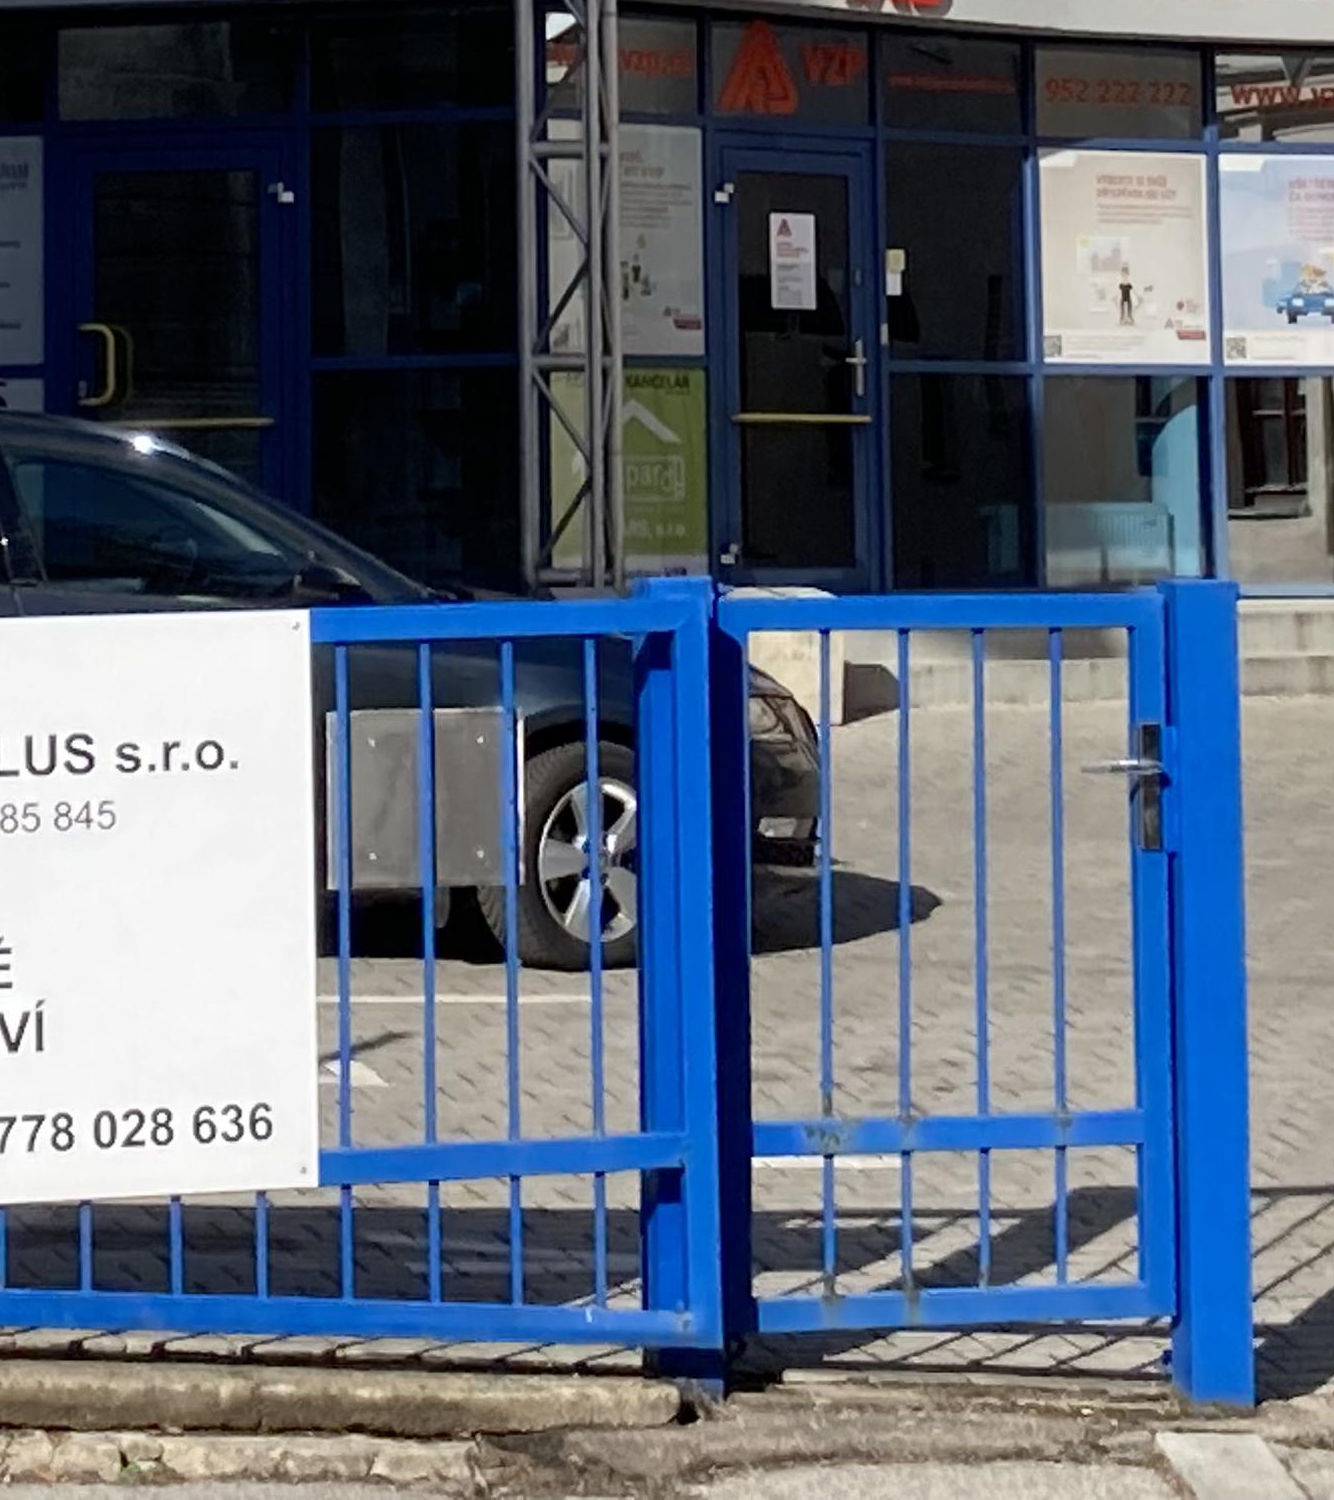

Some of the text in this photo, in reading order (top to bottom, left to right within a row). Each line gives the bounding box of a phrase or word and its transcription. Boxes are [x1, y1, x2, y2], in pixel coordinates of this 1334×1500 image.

[1045, 78, 1089, 102] 952
[116, 740, 238, 774] s.r.o.
[52, 799, 118, 832] 845
[93, 1108, 174, 1149] 028
[193, 1102, 273, 1144] 636
